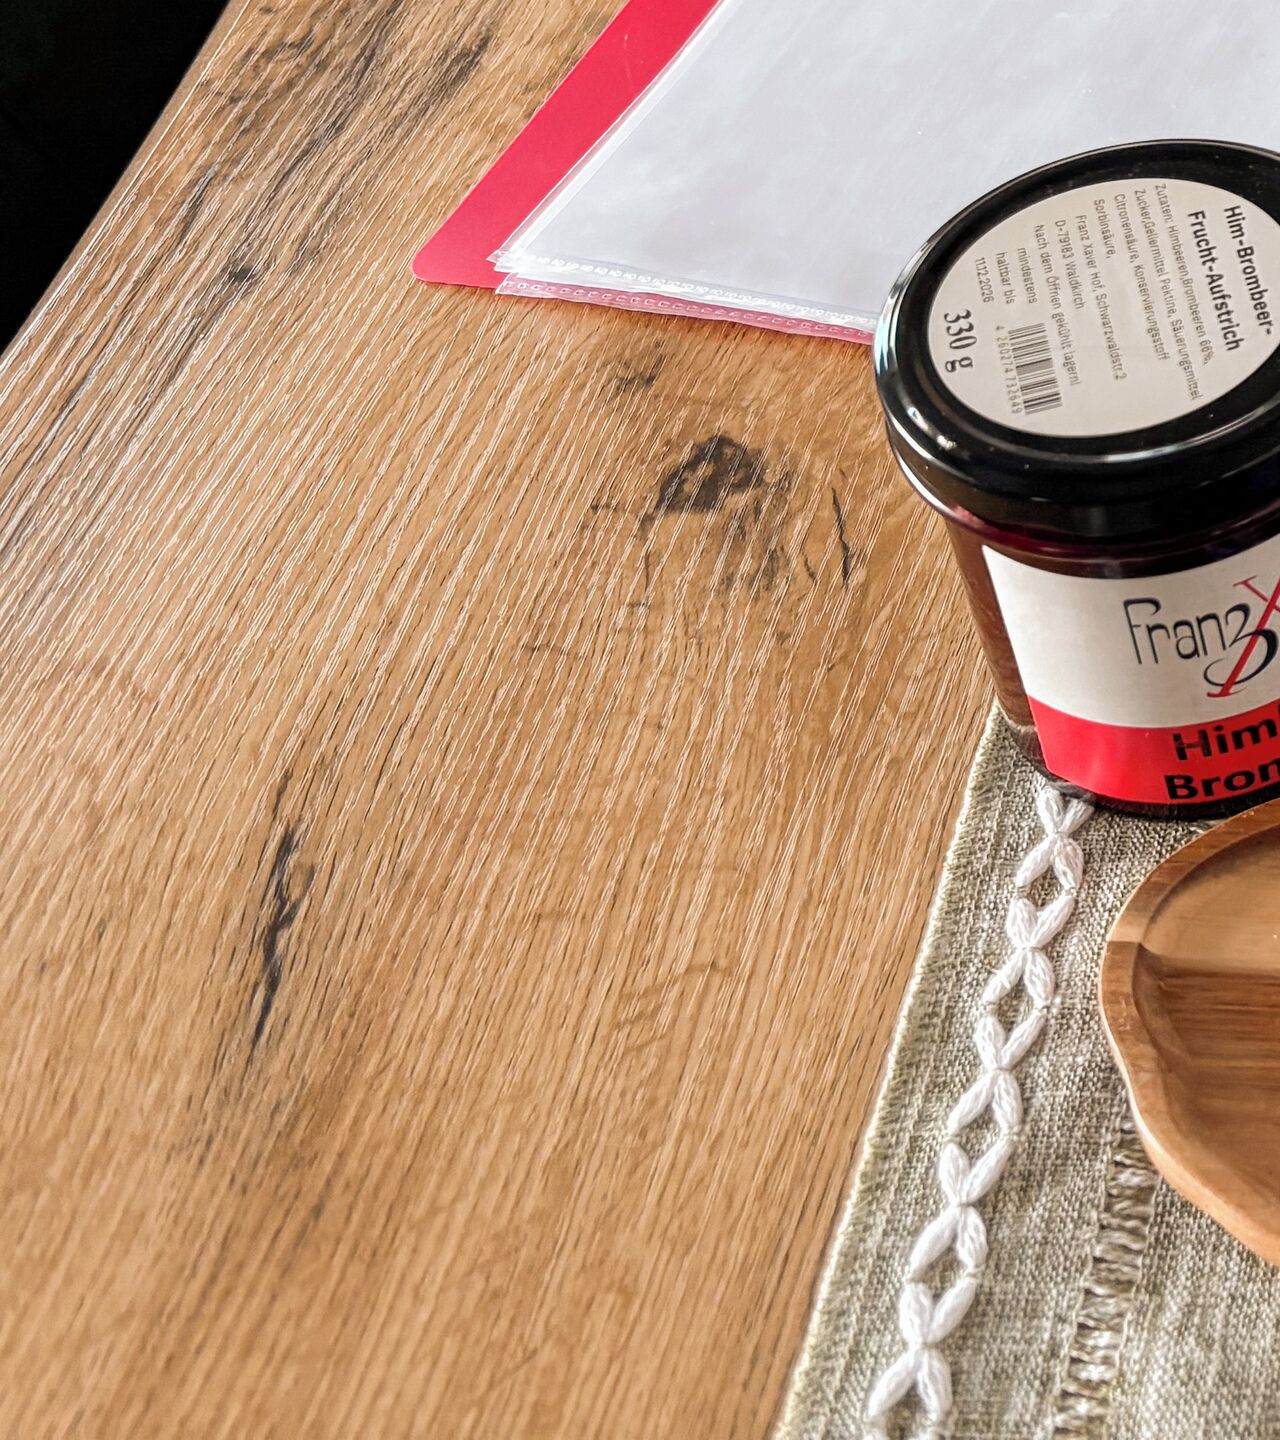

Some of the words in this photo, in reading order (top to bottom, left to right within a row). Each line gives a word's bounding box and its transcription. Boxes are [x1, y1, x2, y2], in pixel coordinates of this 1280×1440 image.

[1017, 248, 1037, 303] mindestens
[1065, 261, 1086, 309] Waldkirch
[1188, 211, 1243, 351] Frucht-Aufstrich
[1224, 206, 1273, 334] Him-Brombeer-
[944, 309, 977, 350] 330
[944, 356, 973, 373] g
